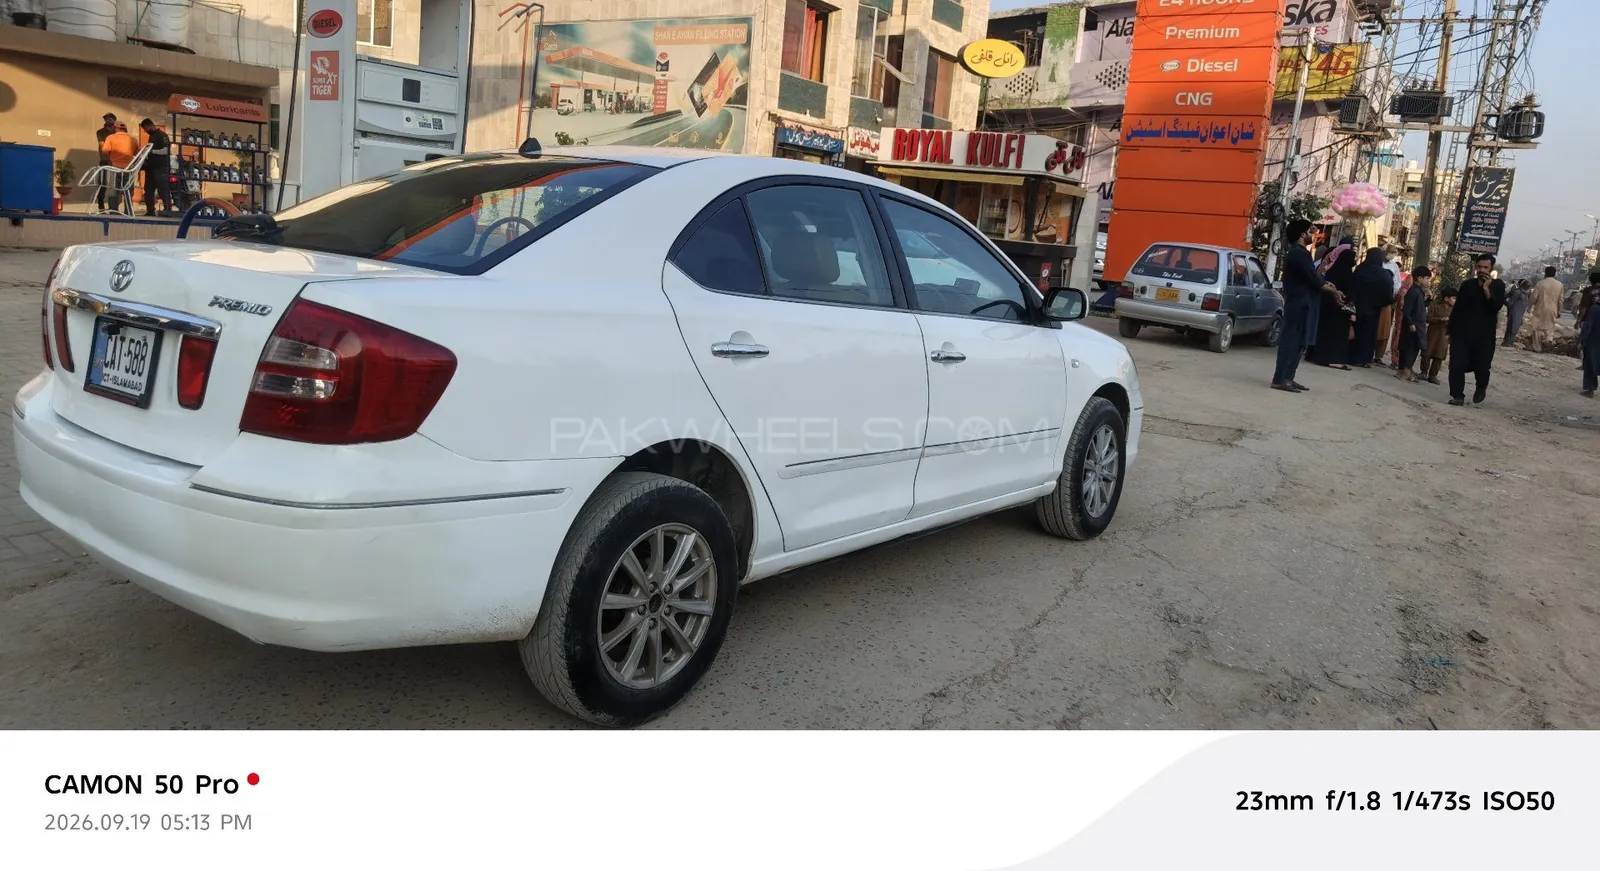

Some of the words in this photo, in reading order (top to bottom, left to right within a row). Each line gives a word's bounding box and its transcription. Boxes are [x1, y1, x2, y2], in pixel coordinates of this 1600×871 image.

[314, 18, 336, 28] DIESEL
[720, 28, 746, 39] STATION
[1165, 26, 1240, 39] Premium
[1187, 59, 1238, 72] Diesel
[1317, 49, 1355, 76] 4G
[312, 85, 332, 96] TIGER
[1175, 92, 1213, 106] CNG
[205, 102, 261, 116] Lubricants
[893, 129, 953, 164] ROYAL
[966, 131, 1025, 168] KULFI
[208, 295, 273, 316] PREMIO
